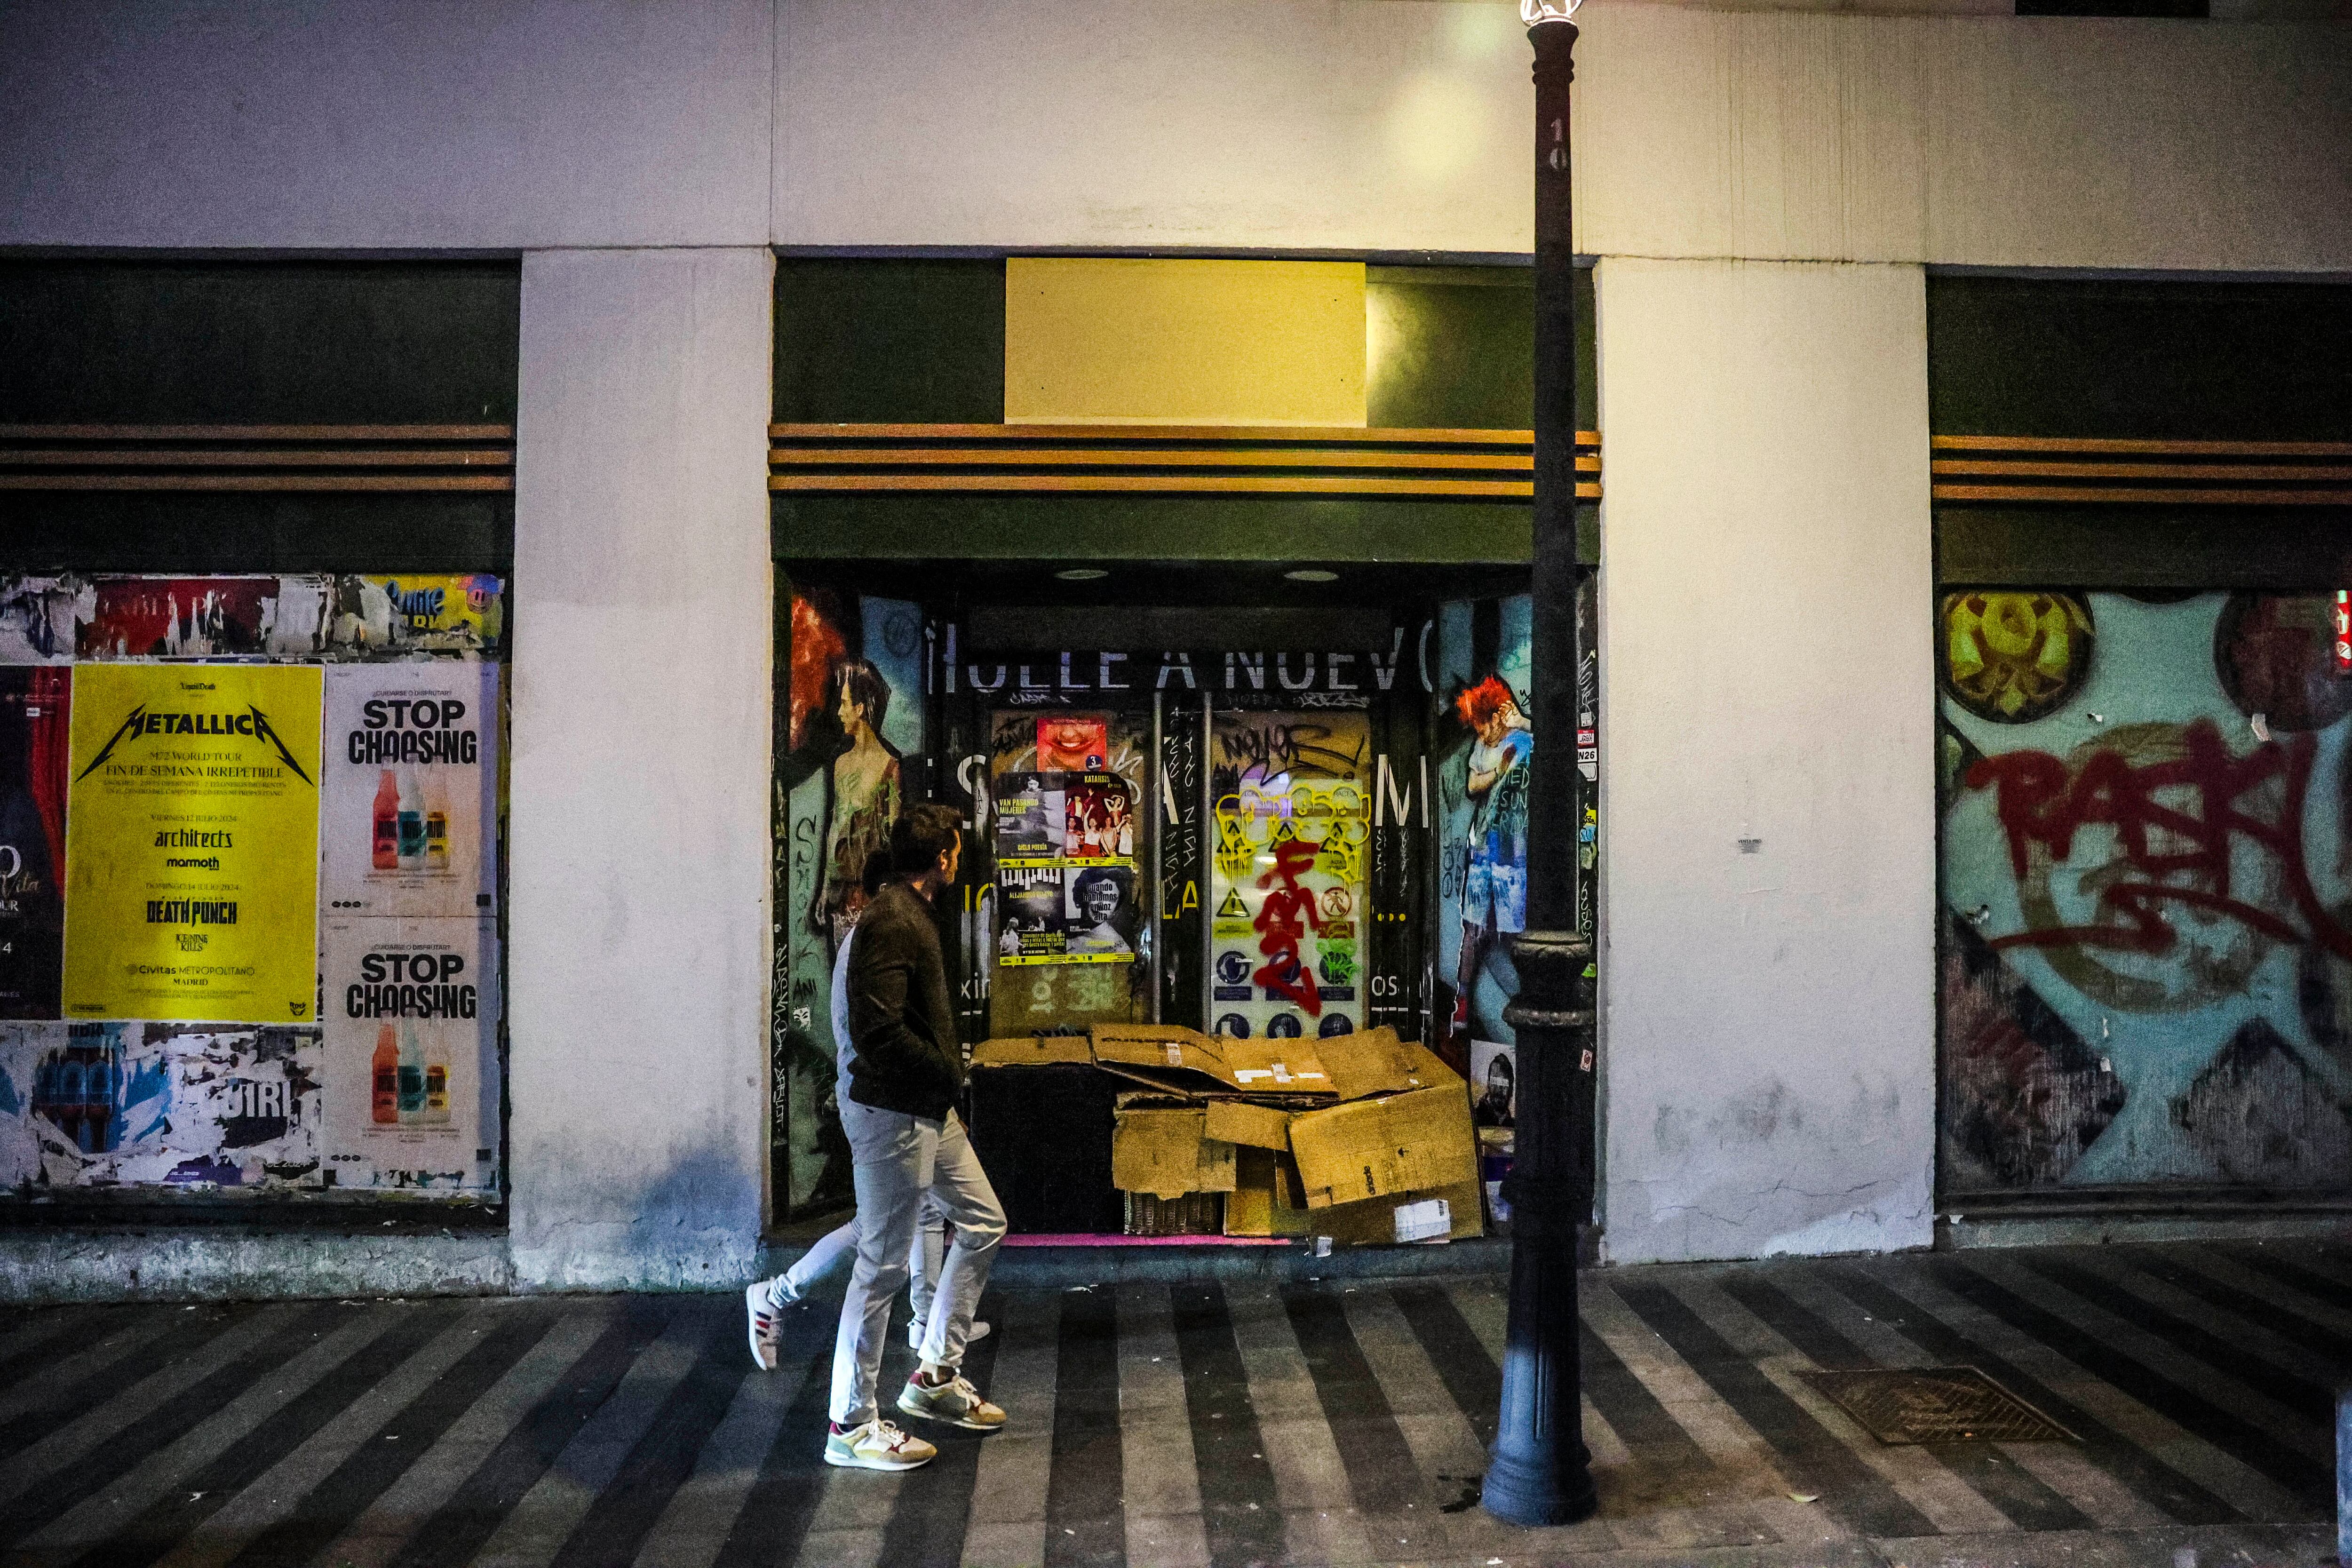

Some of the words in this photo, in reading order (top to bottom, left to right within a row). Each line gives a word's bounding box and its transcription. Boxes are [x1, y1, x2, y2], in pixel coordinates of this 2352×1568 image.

[363, 700, 465, 729] STOP
[74, 704, 314, 787] METALLICA
[348, 730, 477, 764] CHOOSING
[172, 753, 210, 761] WORLD
[213, 753, 242, 762] TOUR
[1090, 756, 1097, 765] 3
[1579, 751, 1595, 760] N26
[106, 765, 126, 775] FIN
[131, 765, 149, 776] DE
[151, 766, 202, 776] SEMANA
[207, 766, 284, 777] IRREPETIBLE
[155, 829, 232, 848] architects
[192, 901, 237, 928] PUNCH
[139, 965, 176, 974] Civitas
[179, 966, 255, 976] METROPOLITANO
[361, 954, 464, 983] STOP
[173, 978, 208, 986] MADRID
[347, 984, 476, 1019] CHOOSING
